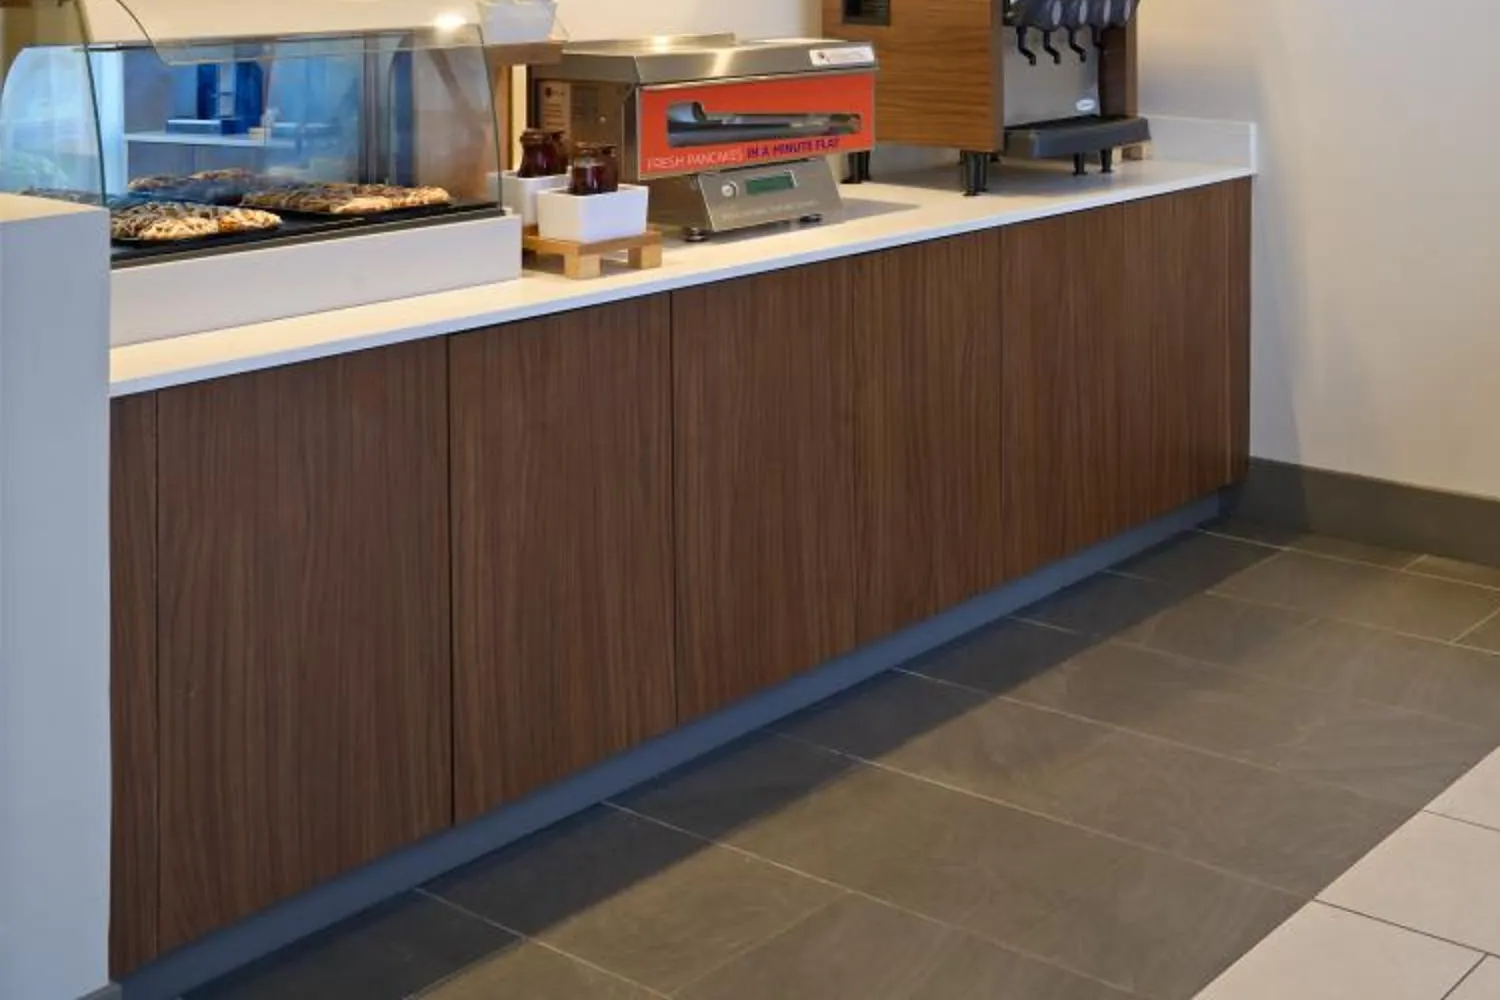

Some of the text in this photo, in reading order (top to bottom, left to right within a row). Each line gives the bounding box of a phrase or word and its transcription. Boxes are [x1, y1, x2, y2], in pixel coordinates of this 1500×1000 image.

[647, 155, 685, 170] FRESH
[687, 150, 744, 166] PANCAKES
[772, 141, 815, 156] MINUTE
[815, 138, 841, 150] FLAT
